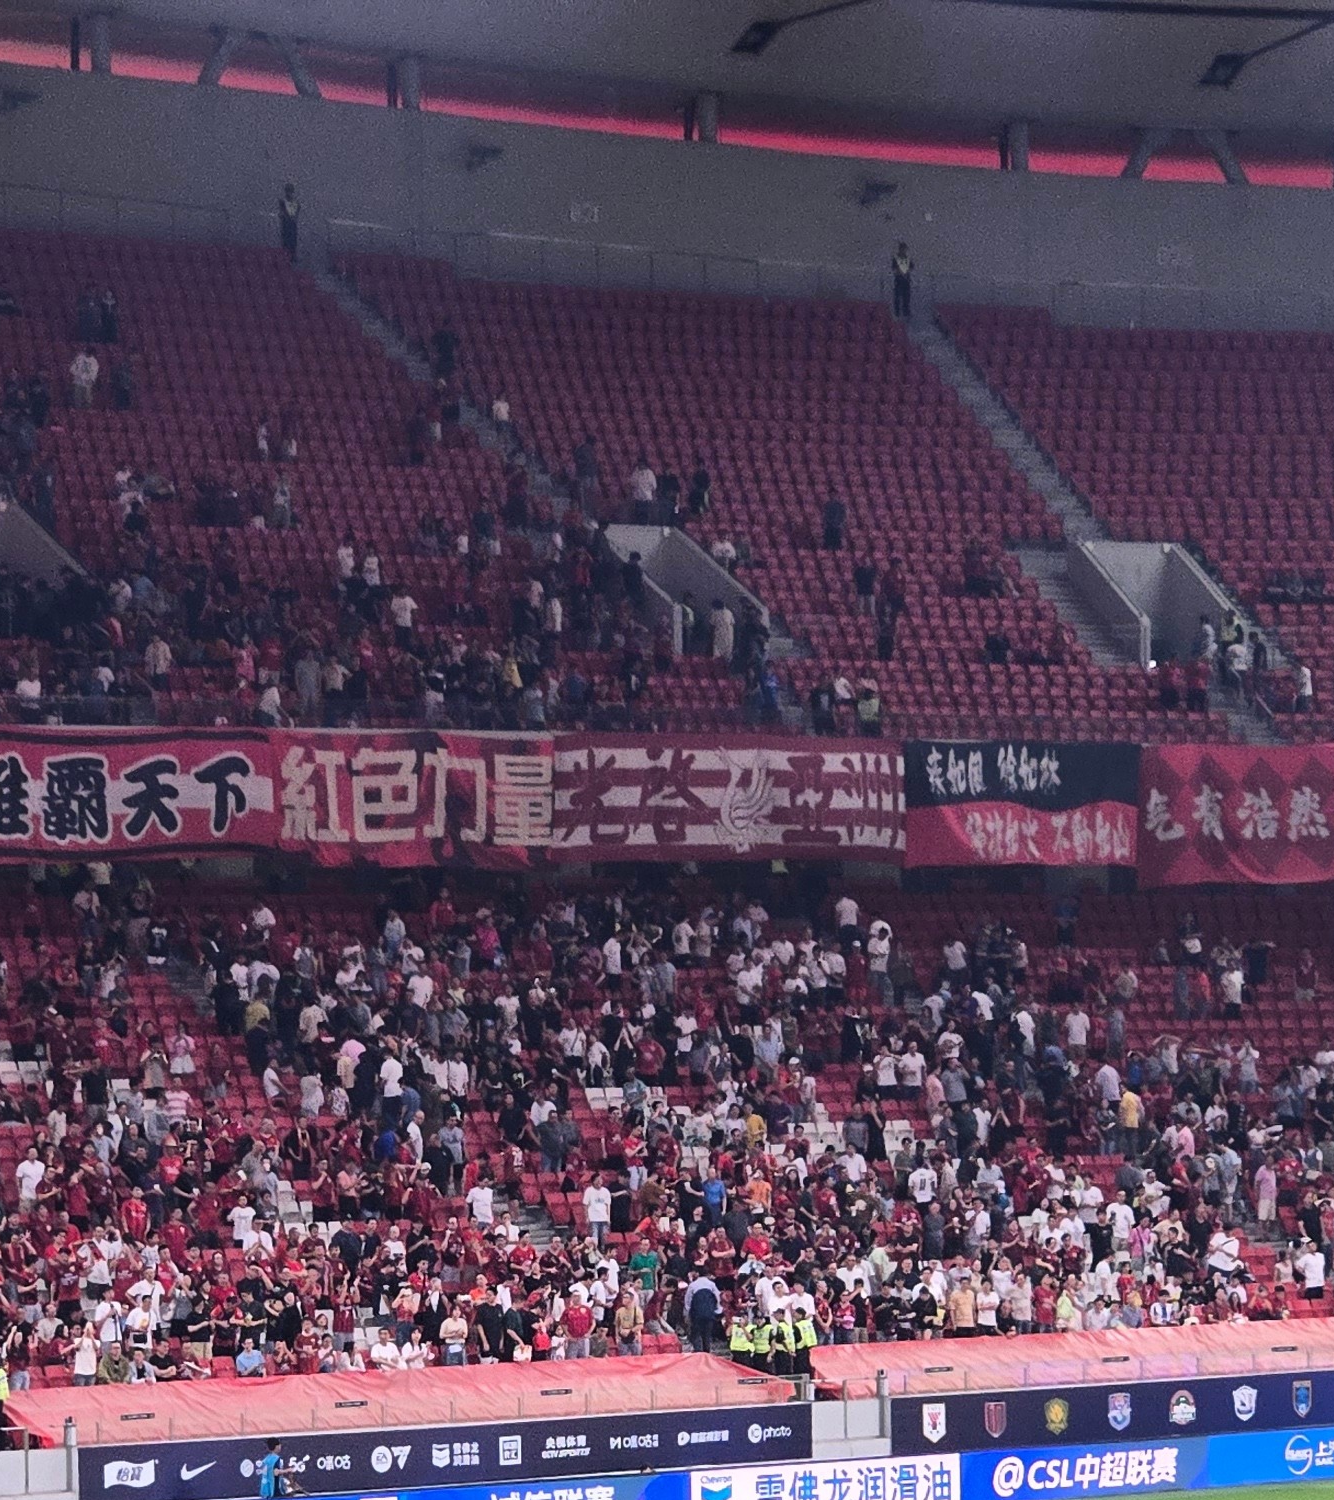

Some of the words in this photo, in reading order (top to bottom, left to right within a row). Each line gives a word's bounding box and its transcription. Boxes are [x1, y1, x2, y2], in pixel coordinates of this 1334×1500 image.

[280, 744, 553, 848] 紅色力量
[763, 1425, 793, 1441] photo
